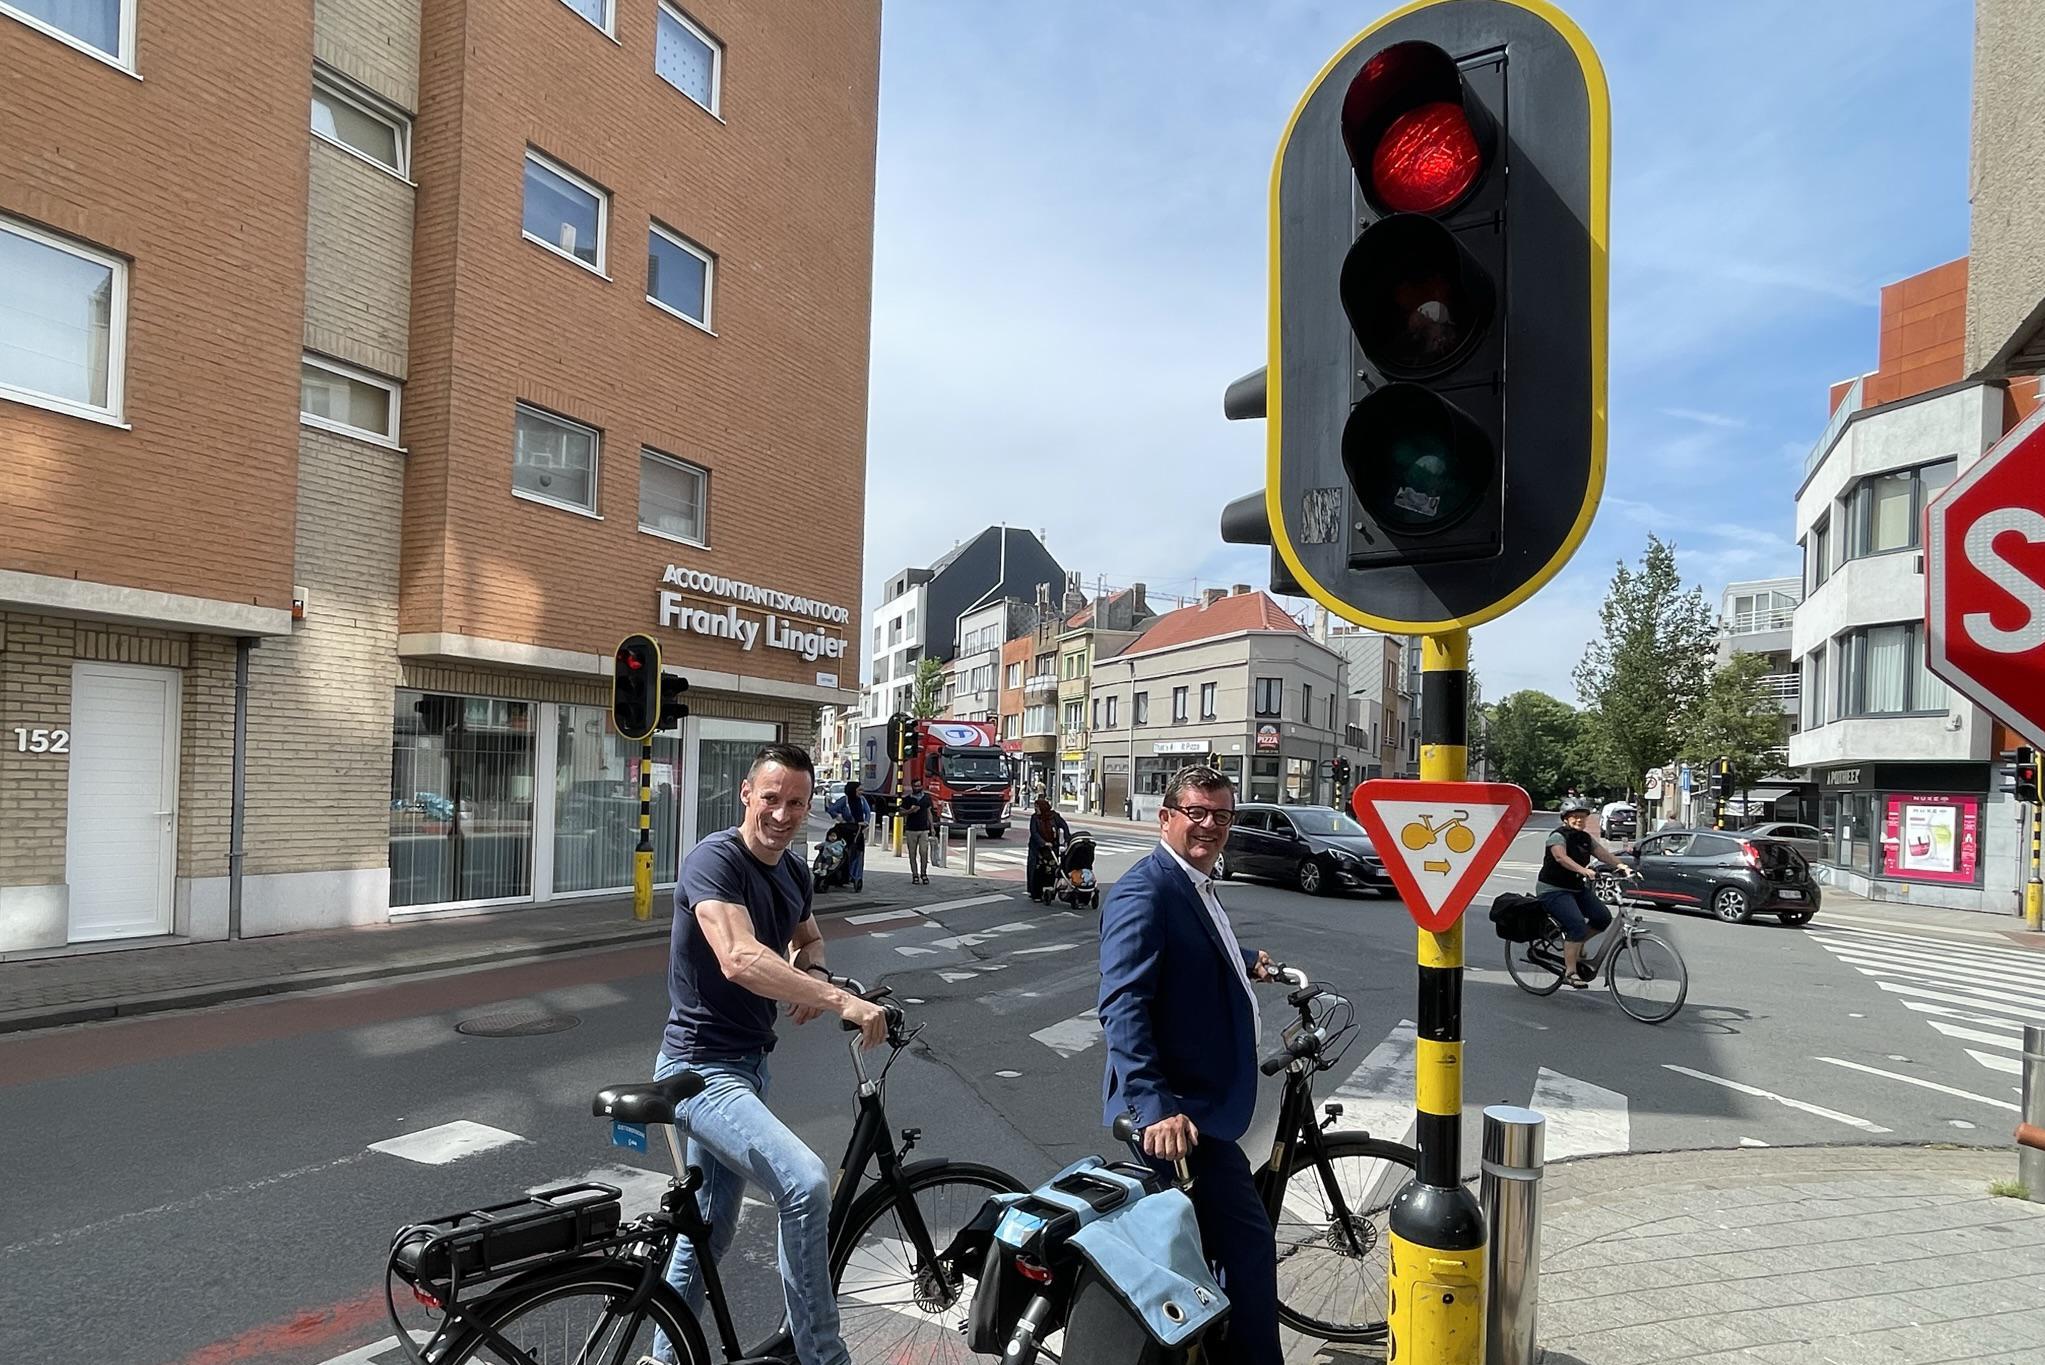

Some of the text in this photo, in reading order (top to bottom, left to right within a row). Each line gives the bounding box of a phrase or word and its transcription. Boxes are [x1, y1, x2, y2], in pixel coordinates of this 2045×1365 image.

[662, 564, 850, 624] ACCOUNTANTSKANTOOR
[659, 590, 848, 662] Franky Lingier
[14, 728, 70, 753] 152
[1257, 736, 1279, 744] PIZZA
